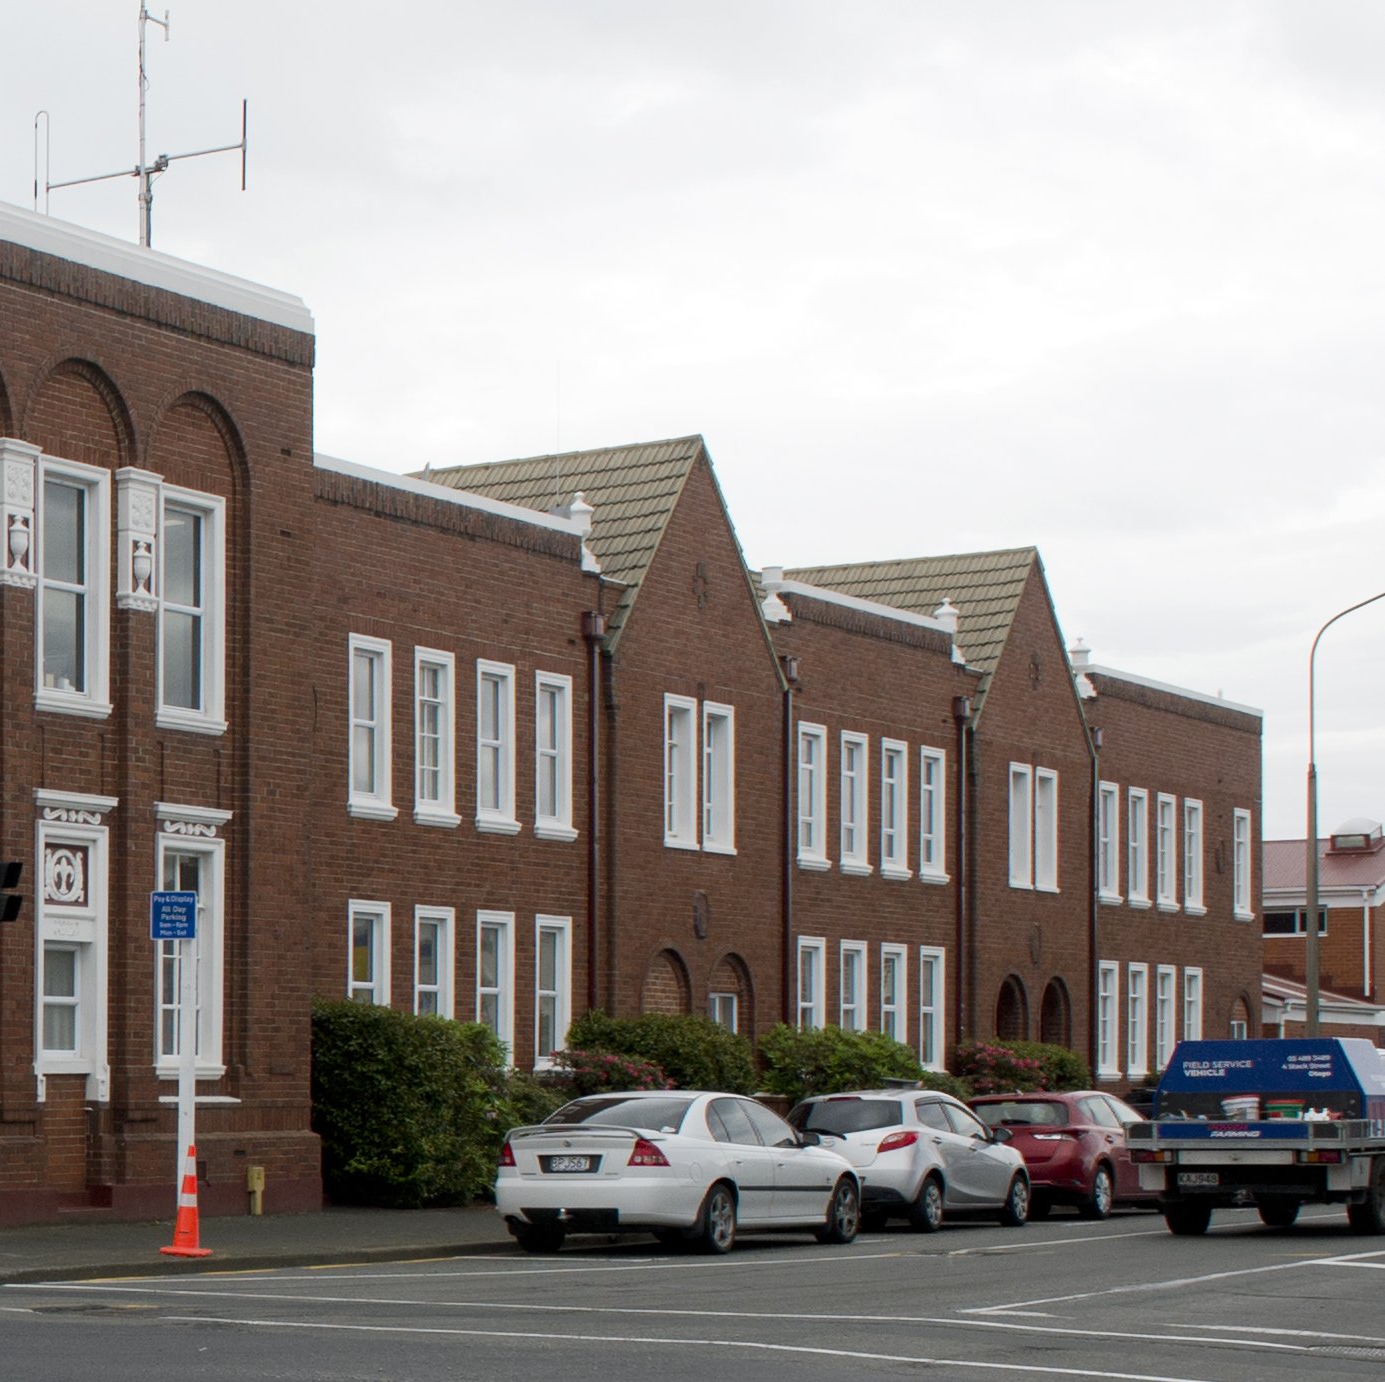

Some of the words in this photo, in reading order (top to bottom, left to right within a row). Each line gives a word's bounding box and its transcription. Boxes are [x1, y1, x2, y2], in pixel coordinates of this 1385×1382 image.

[171, 895, 193, 904] Display
[1183, 1061, 1210, 1069] FIELD
[1212, 1060, 1252, 1068] SERVICE
[1184, 1068, 1226, 1077] VEHICLE
[1179, 1173, 1217, 1184] KAJ948
